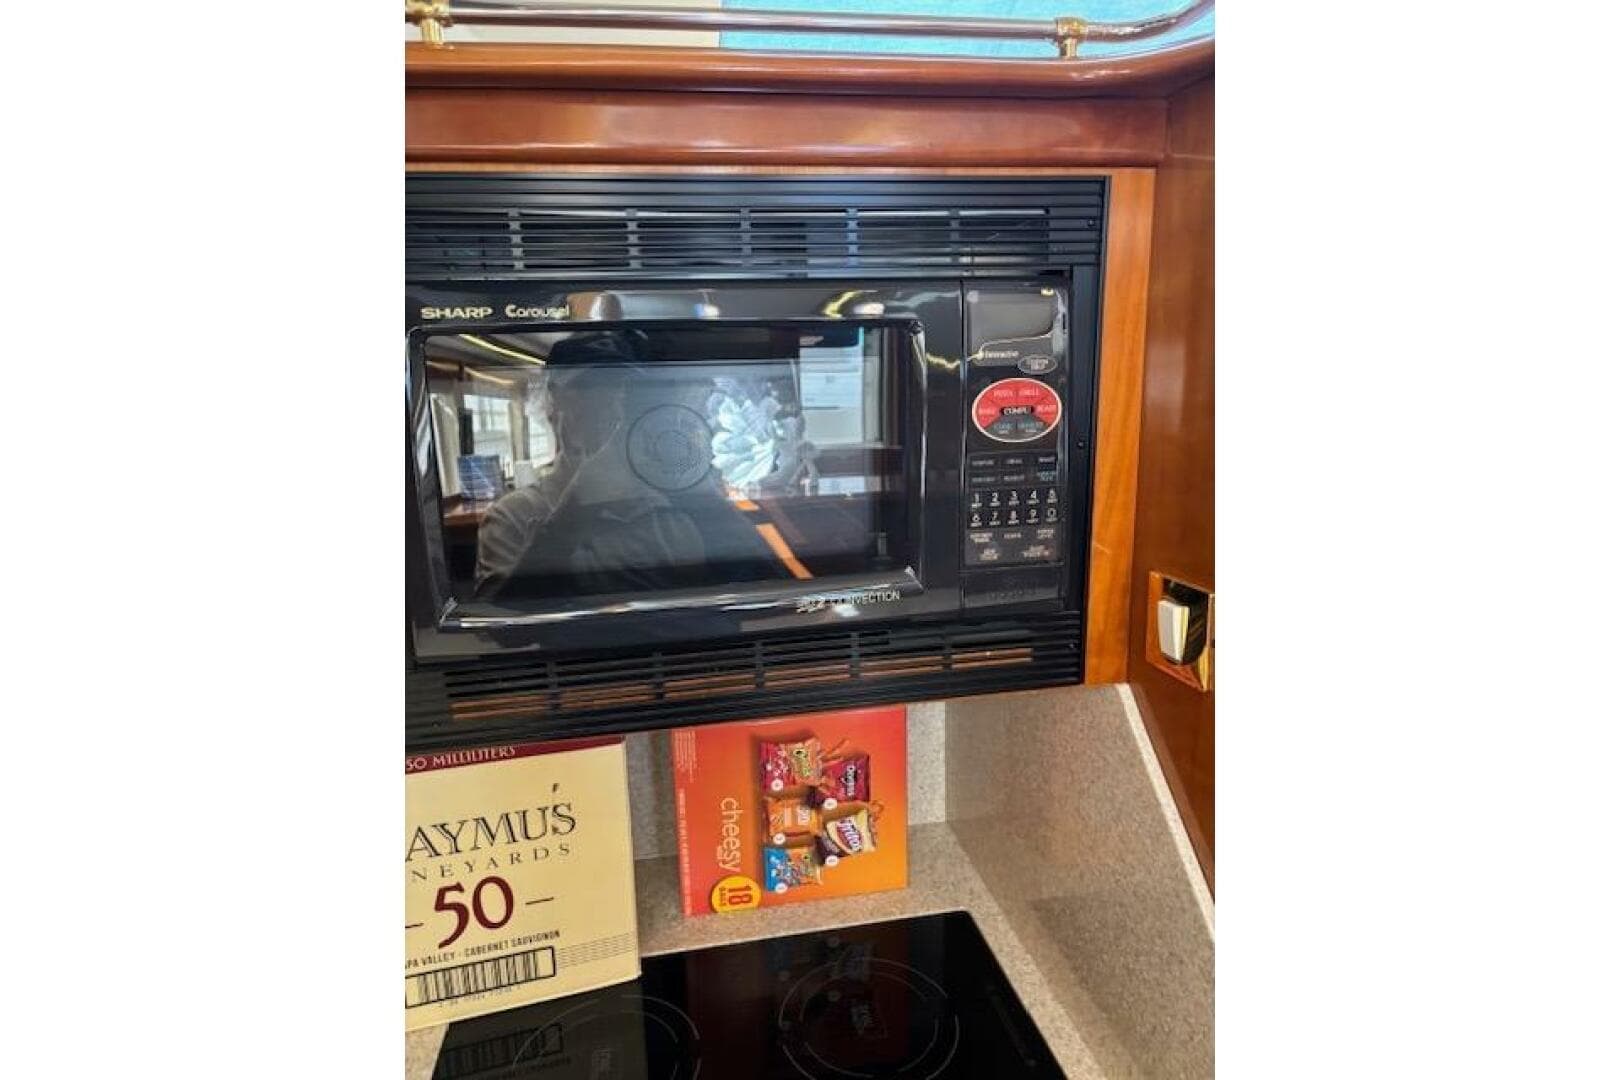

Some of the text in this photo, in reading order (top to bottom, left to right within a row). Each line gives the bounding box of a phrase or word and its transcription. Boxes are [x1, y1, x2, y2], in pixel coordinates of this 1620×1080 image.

[421, 304, 570, 319] SHARP Carousel
[433, 746, 516, 767] MILLILITERS
[718, 797, 744, 872] cheesy
[838, 817, 863, 852] Fritos
[434, 876, 515, 949] 50
[728, 885, 753, 905] 18
[421, 951, 455, 966] VALLEY
[464, 940, 509, 957] CABERNET
[511, 929, 561, 947] SAUVIGNON
